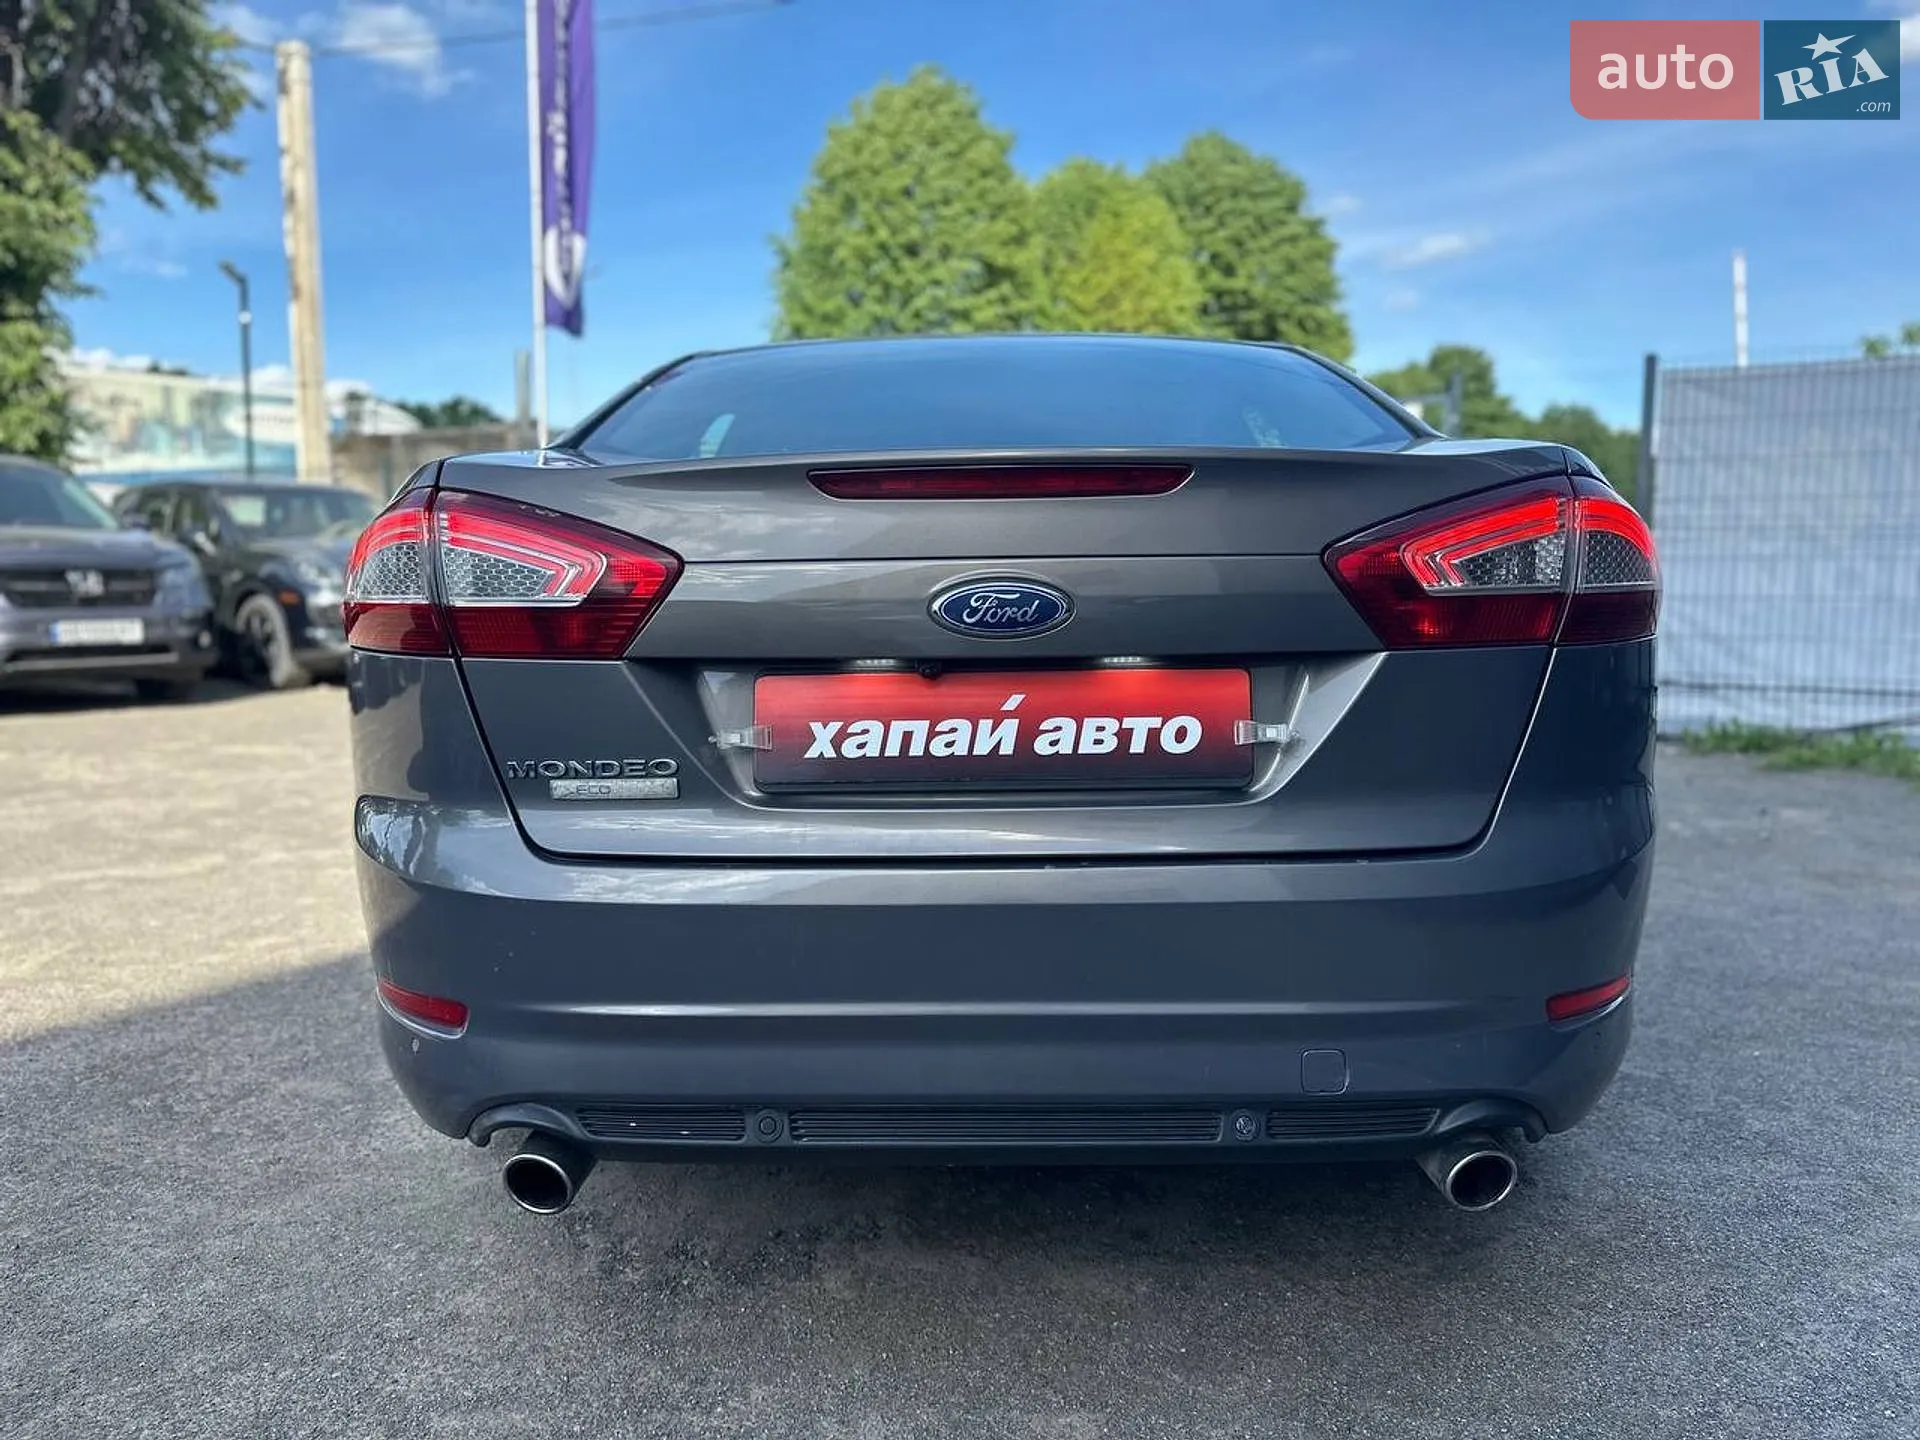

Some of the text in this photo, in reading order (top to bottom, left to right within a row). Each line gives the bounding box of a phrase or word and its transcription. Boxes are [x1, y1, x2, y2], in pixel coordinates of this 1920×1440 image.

[962, 592, 1040, 624] Ford
[1033, 715, 1204, 756] авто
[506, 758, 679, 779] MONDEO
